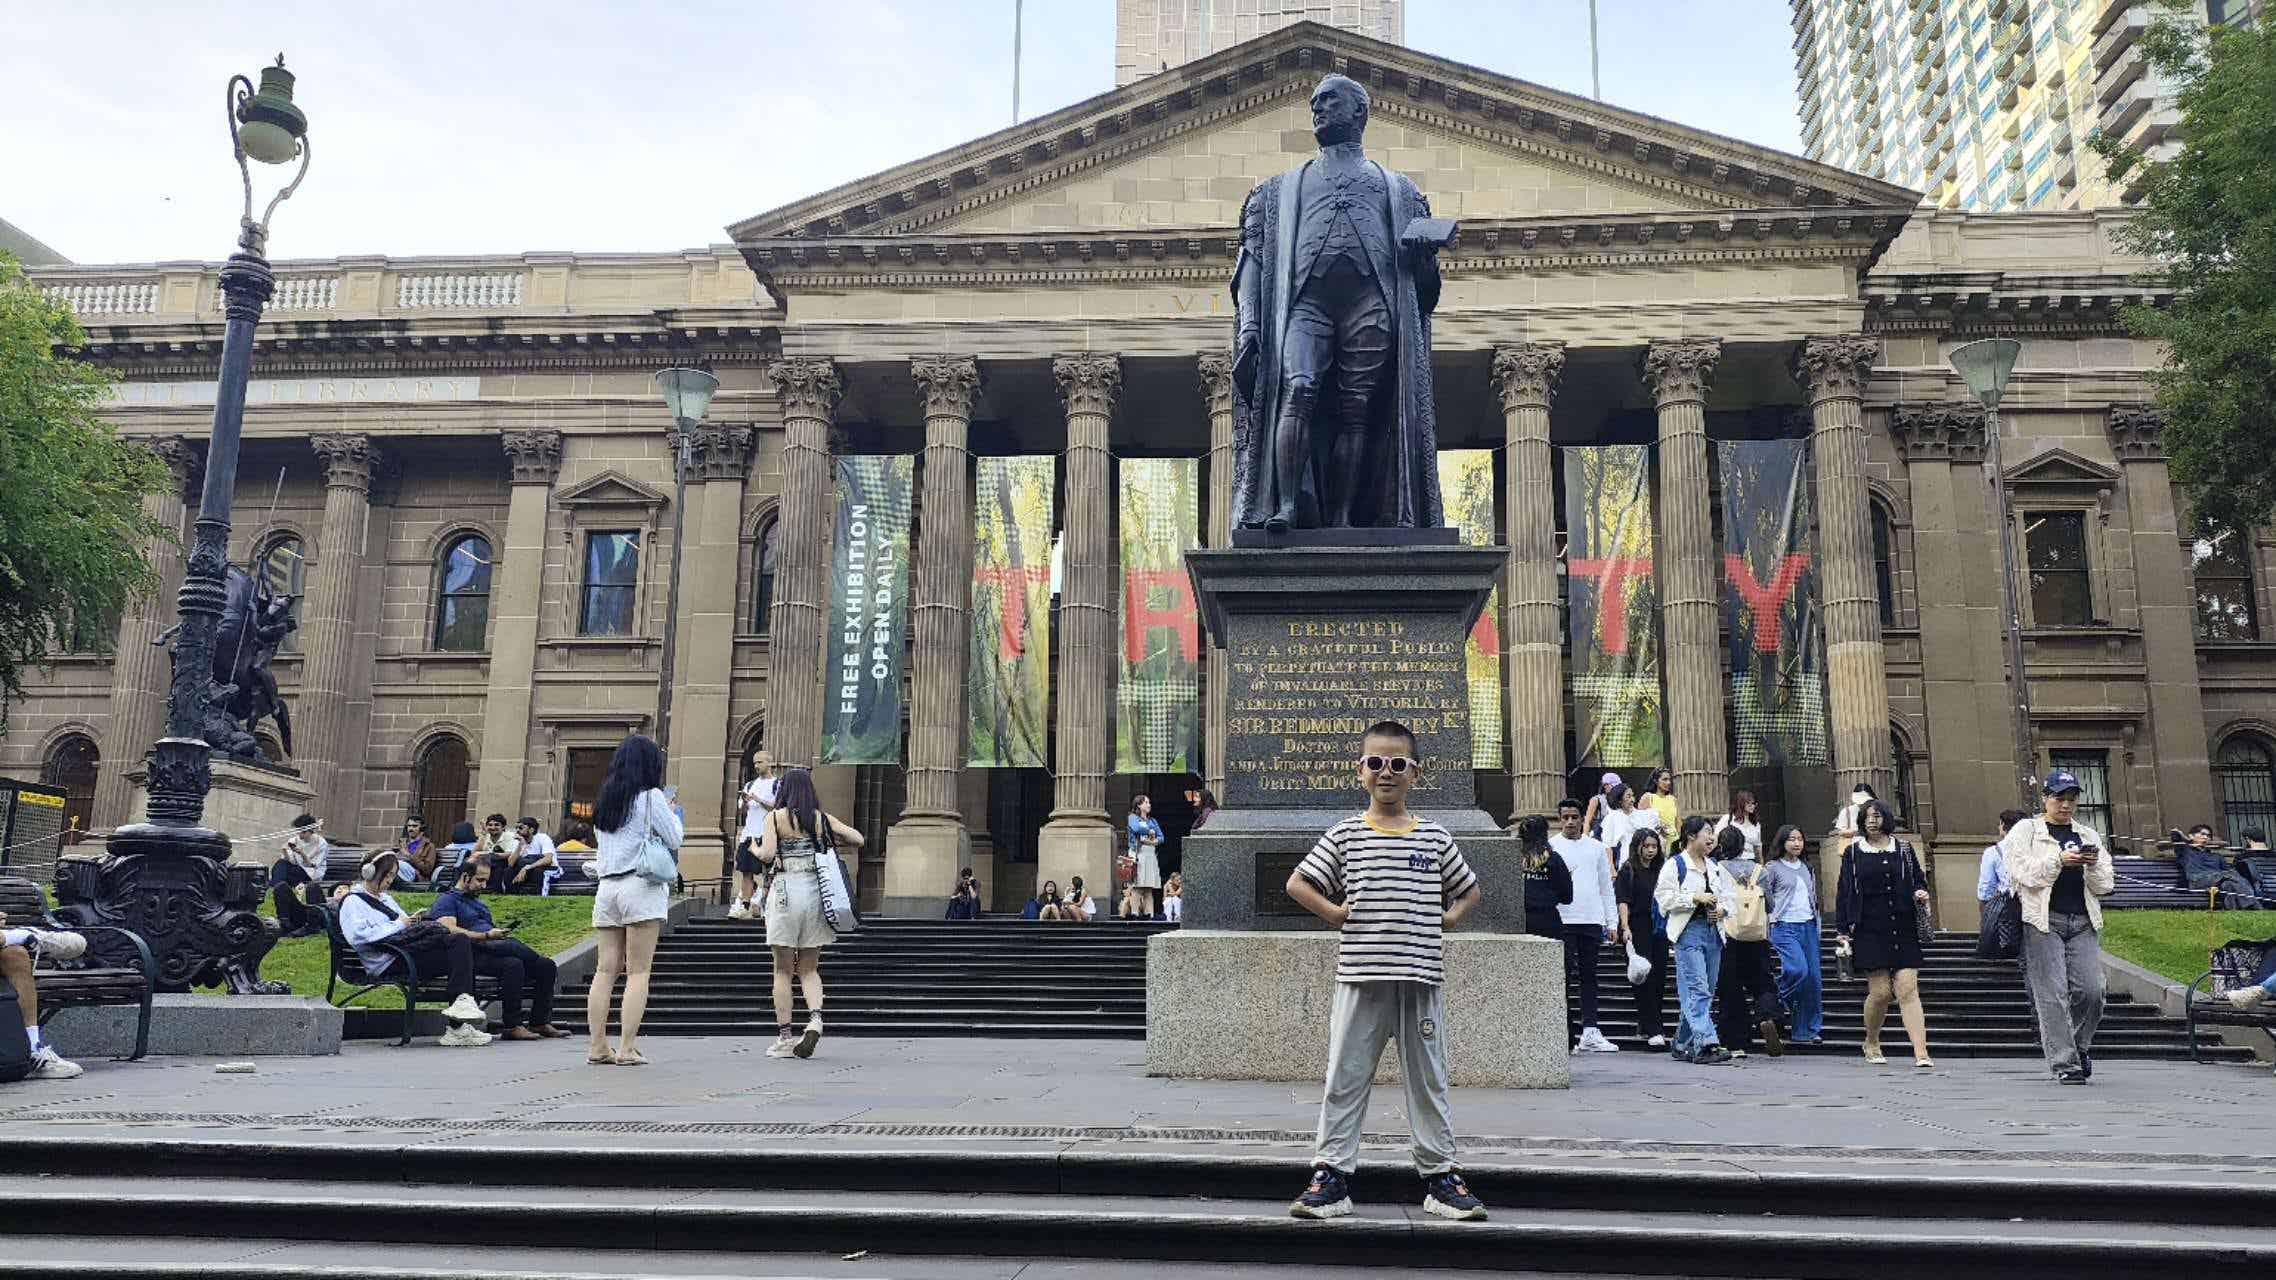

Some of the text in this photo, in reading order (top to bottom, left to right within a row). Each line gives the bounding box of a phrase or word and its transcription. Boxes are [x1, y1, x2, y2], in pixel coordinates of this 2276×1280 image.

[840, 504, 868, 714] FREE EXHIBITION
[871, 536, 893, 680] OPEN DAILY
[1287, 622, 1404, 637] ERECTED
[1239, 639, 1456, 656] BY A GRATEFUL PUBLIC
[1343, 694, 1436, 709] VICTORIA
[1230, 717, 1266, 734] SIR
[1268, 717, 1366, 735] REDMOND
